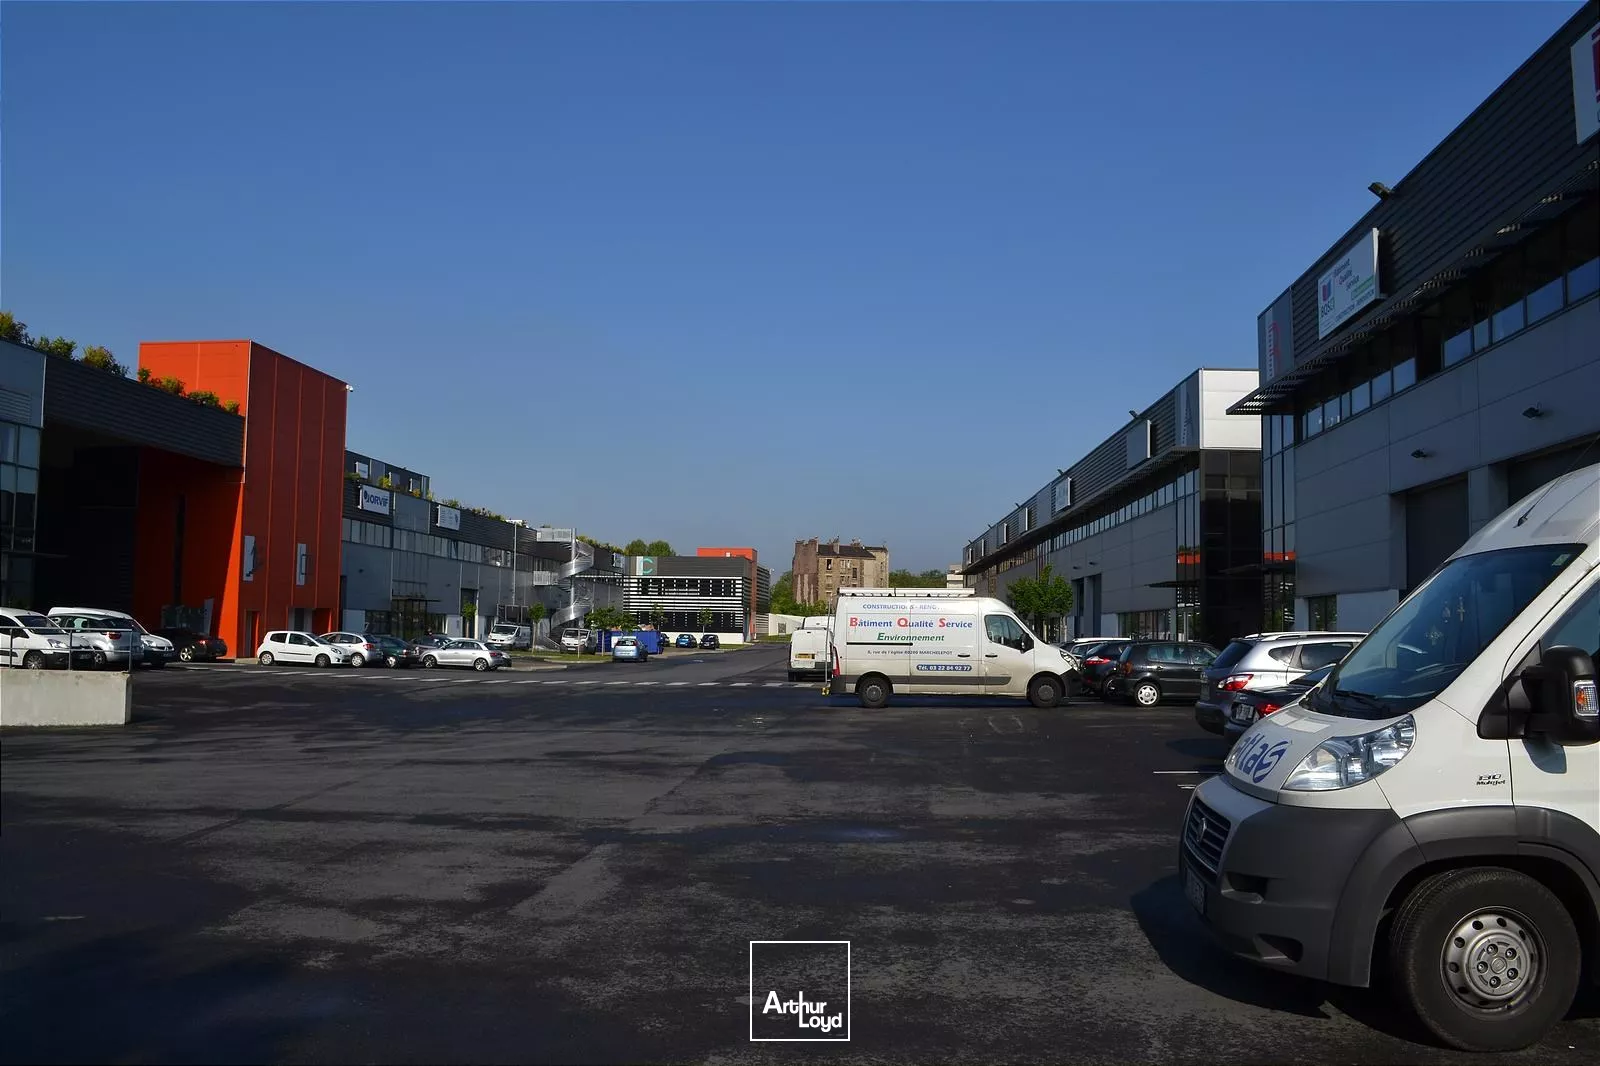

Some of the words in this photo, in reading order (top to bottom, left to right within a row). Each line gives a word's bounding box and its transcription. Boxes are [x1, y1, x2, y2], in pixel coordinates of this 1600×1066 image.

[849, 617, 893, 628] Bâtiment
[897, 617, 934, 629] Qualité
[938, 617, 973, 629] Service
[877, 632, 945, 642] Environnement
